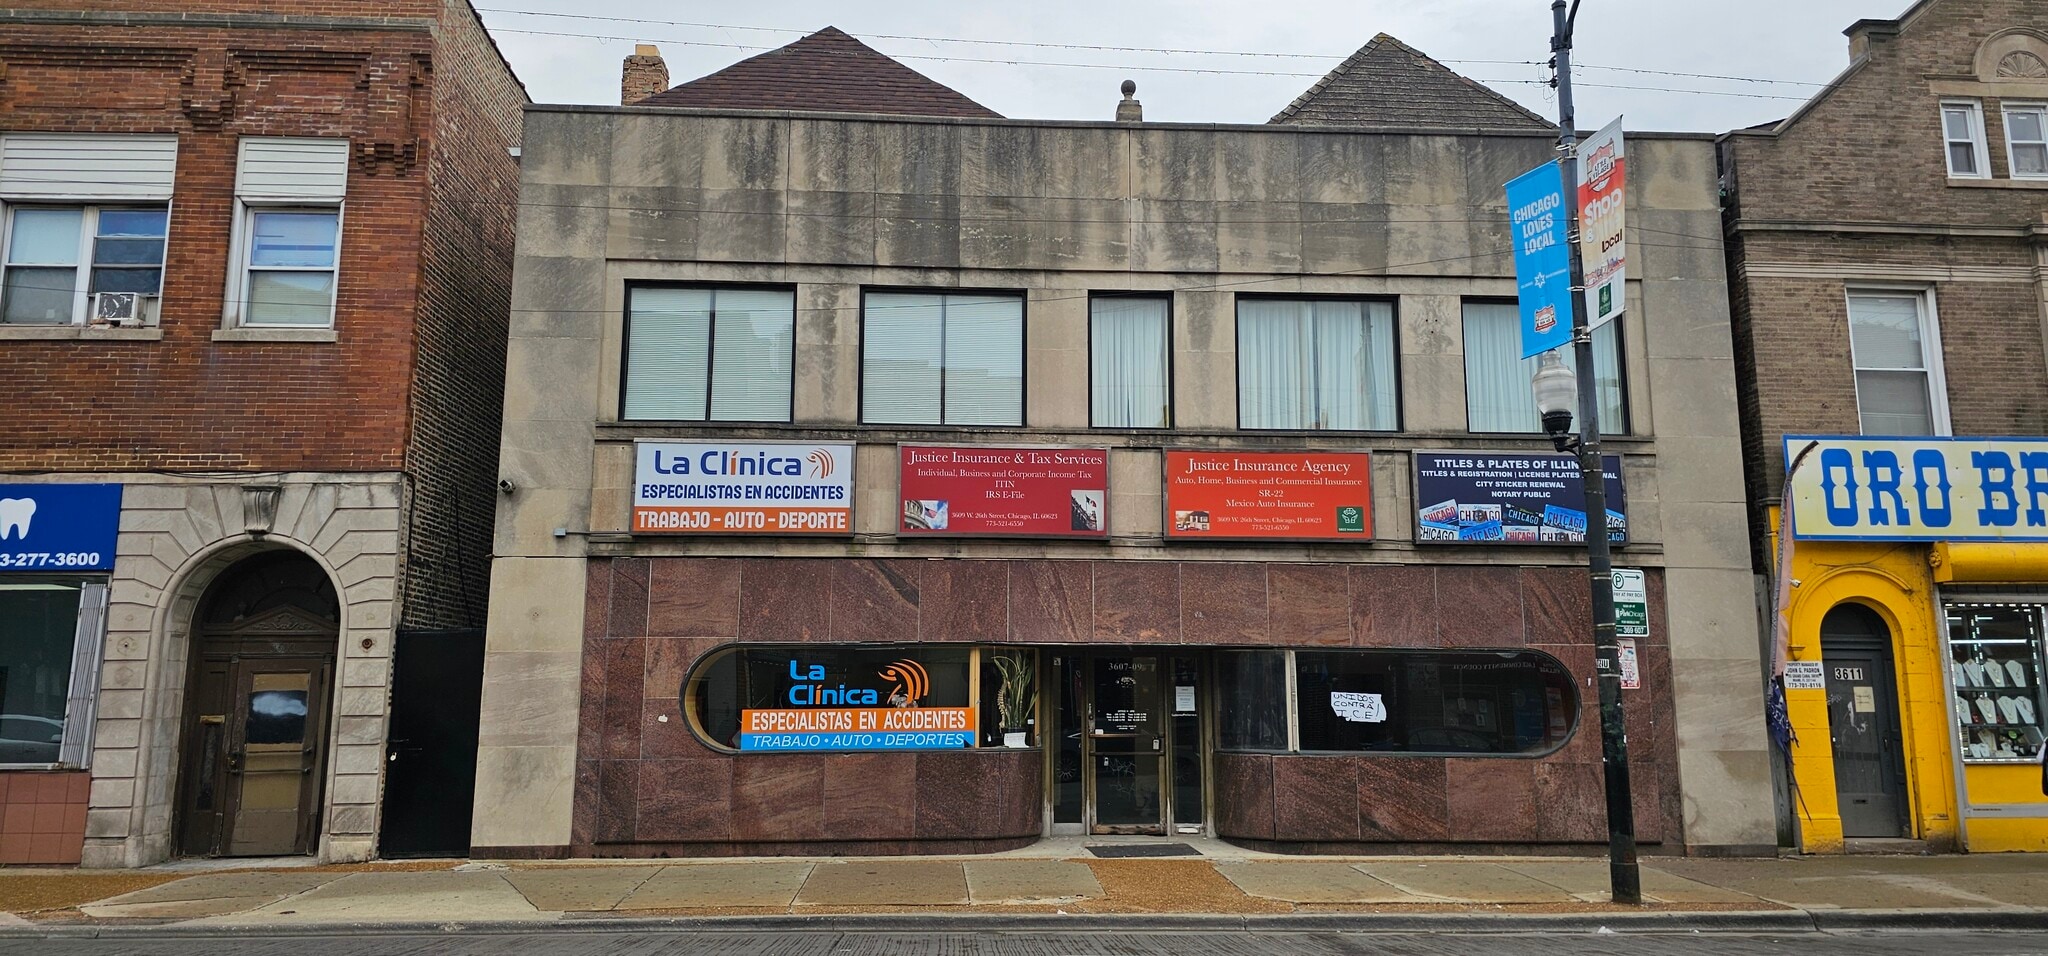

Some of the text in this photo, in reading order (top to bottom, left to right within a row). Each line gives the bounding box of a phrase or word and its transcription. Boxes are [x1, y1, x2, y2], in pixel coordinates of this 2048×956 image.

[1514, 192, 1560, 224] CHICAGO
[1584, 187, 1622, 226] Shop
[1523, 213, 1553, 239] LOVES
[1525, 231, 1555, 256] LOCAL
[654, 450, 802, 476] La Clínica
[907, 451, 1102, 465] Justice Insurance & Tax Services
[1434, 459, 1473, 468] TITLES
[1476, 460, 1485, 468] &
[1488, 460, 1529, 469] PLATES
[1533, 460, 1547, 469] OF
[918, 469, 958, 478] Individual,
[960, 469, 991, 477] Business
[1008, 470, 1047, 479] Corporate
[1048, 470, 1075, 478] Income
[1186, 458, 1351, 475] Justice Insurance Agency
[995, 480, 1015, 488] ITIN
[1175, 477, 1195, 485] Auto,
[1198, 477, 1223, 485] Home,
[1226, 477, 1257, 485] Business
[1259, 477, 1274, 485] and
[1819, 448, 1952, 528] ORO
[642, 484, 844, 500] ESPECIALISTAS EN ACCIDENTES
[985, 491, 1025, 499] IRS E-File
[1258, 490, 1284, 498] SR-22
[1277, 500, 1314, 508] Insurance
[638, 511, 711, 528] TRABAJO
[724, 511, 765, 529] AUTO
[779, 512, 846, 529] DEPORTE
[1423, 506, 1456, 522] CHICAGO
[1460, 510, 1500, 522] CHIAGO
[1508, 509, 1539, 525] CHICAGO
[1547, 512, 1584, 529] CHICAGO
[1463, 526, 1500, 540] CHICAGO
[789, 659, 825, 680] La
[1835, 668, 1862, 680] 3611
[789, 684, 878, 705] Clínica
[1333, 693, 1375, 704] UNIDOS
[1333, 700, 1374, 710] CONTRA
[752, 710, 966, 731] ESPECIALISTAS EN ACCIDENTES
[752, 733, 964, 748] TRABAJO AUTO DEPORTES
